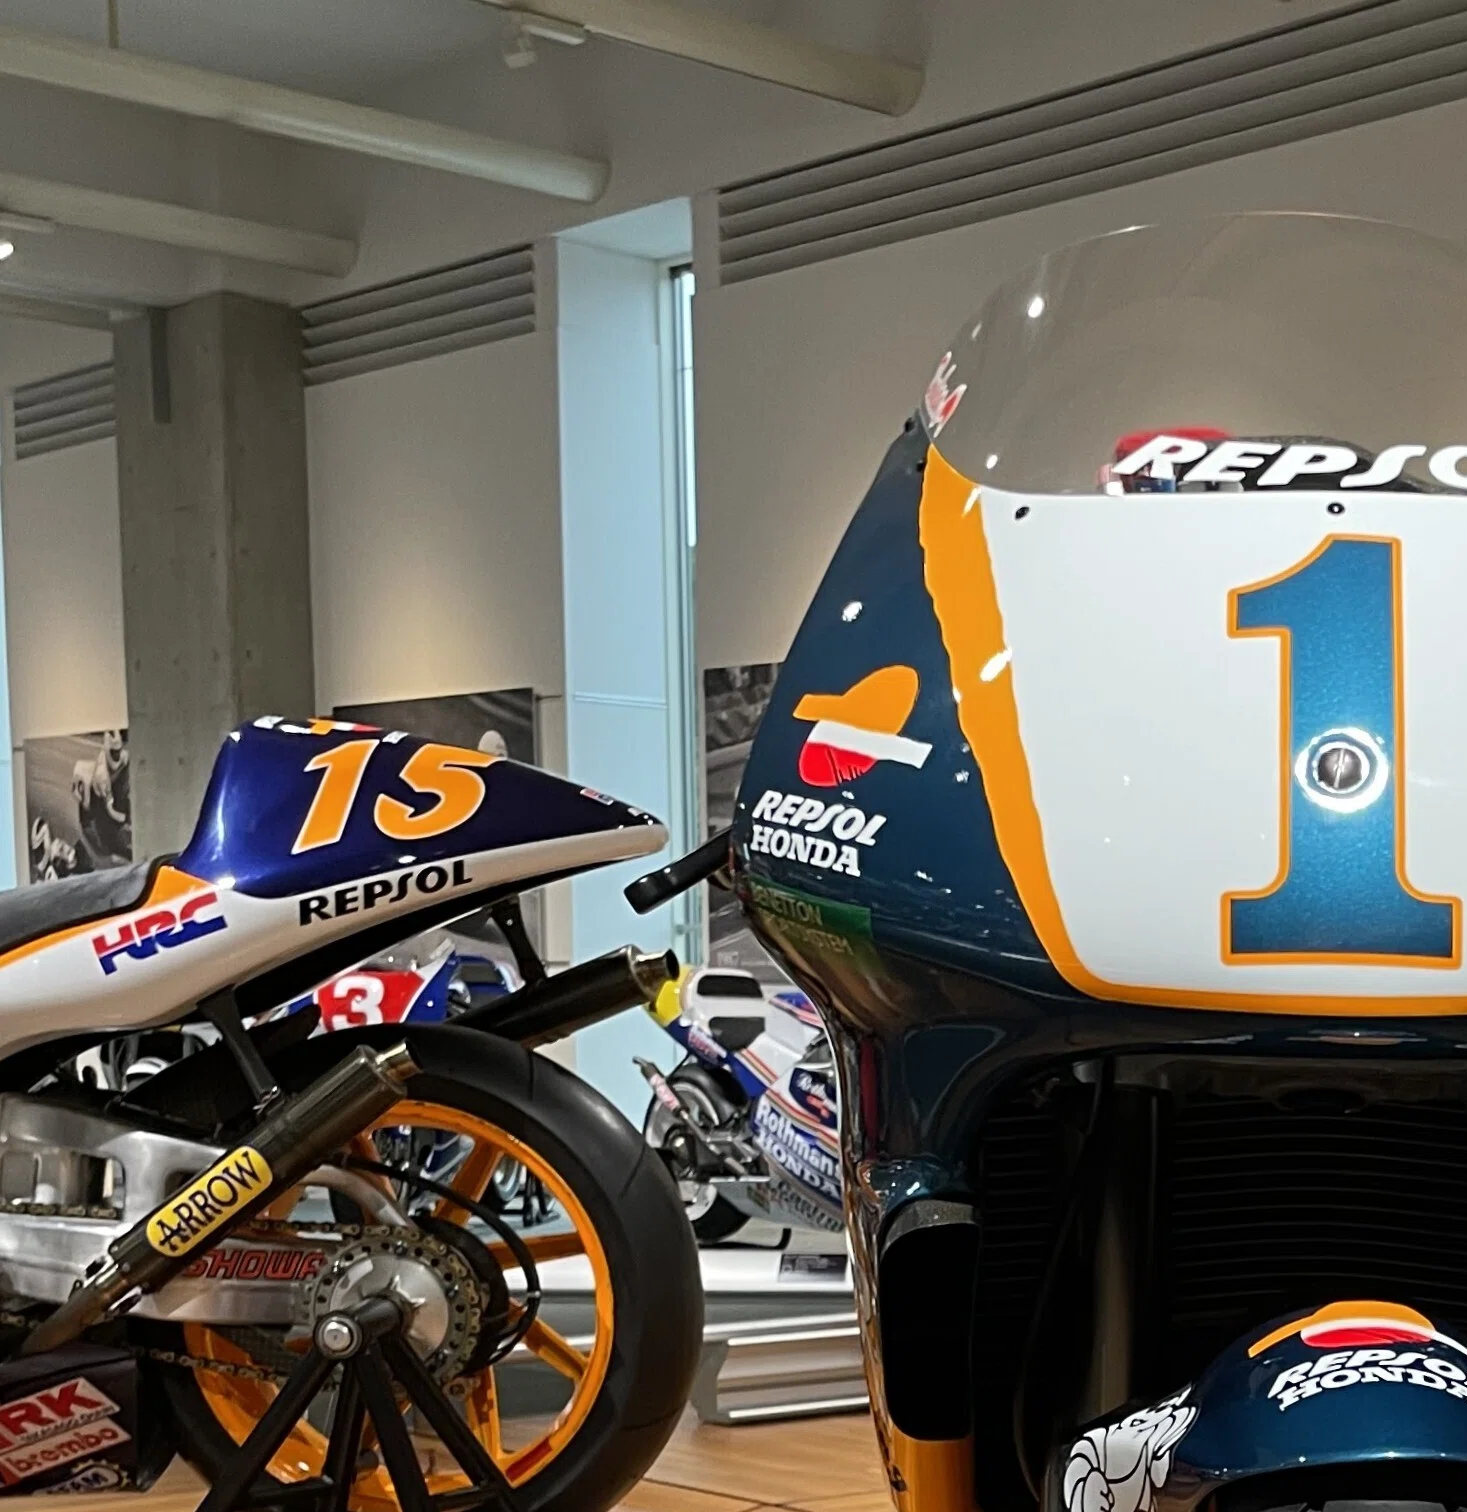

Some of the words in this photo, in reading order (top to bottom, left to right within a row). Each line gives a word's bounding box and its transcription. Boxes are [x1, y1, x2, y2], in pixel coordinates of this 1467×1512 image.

[1221, 533, 1463, 969] 1
[291, 738, 501, 856] 15
[752, 790, 887, 847] REPSOL
[750, 824, 861, 878] HONDA
[300, 860, 473, 927] REPSOL
[91, 892, 228, 977] HRC
[157, 1150, 262, 1253] ARROW
[0, 1381, 107, 1437] RK
